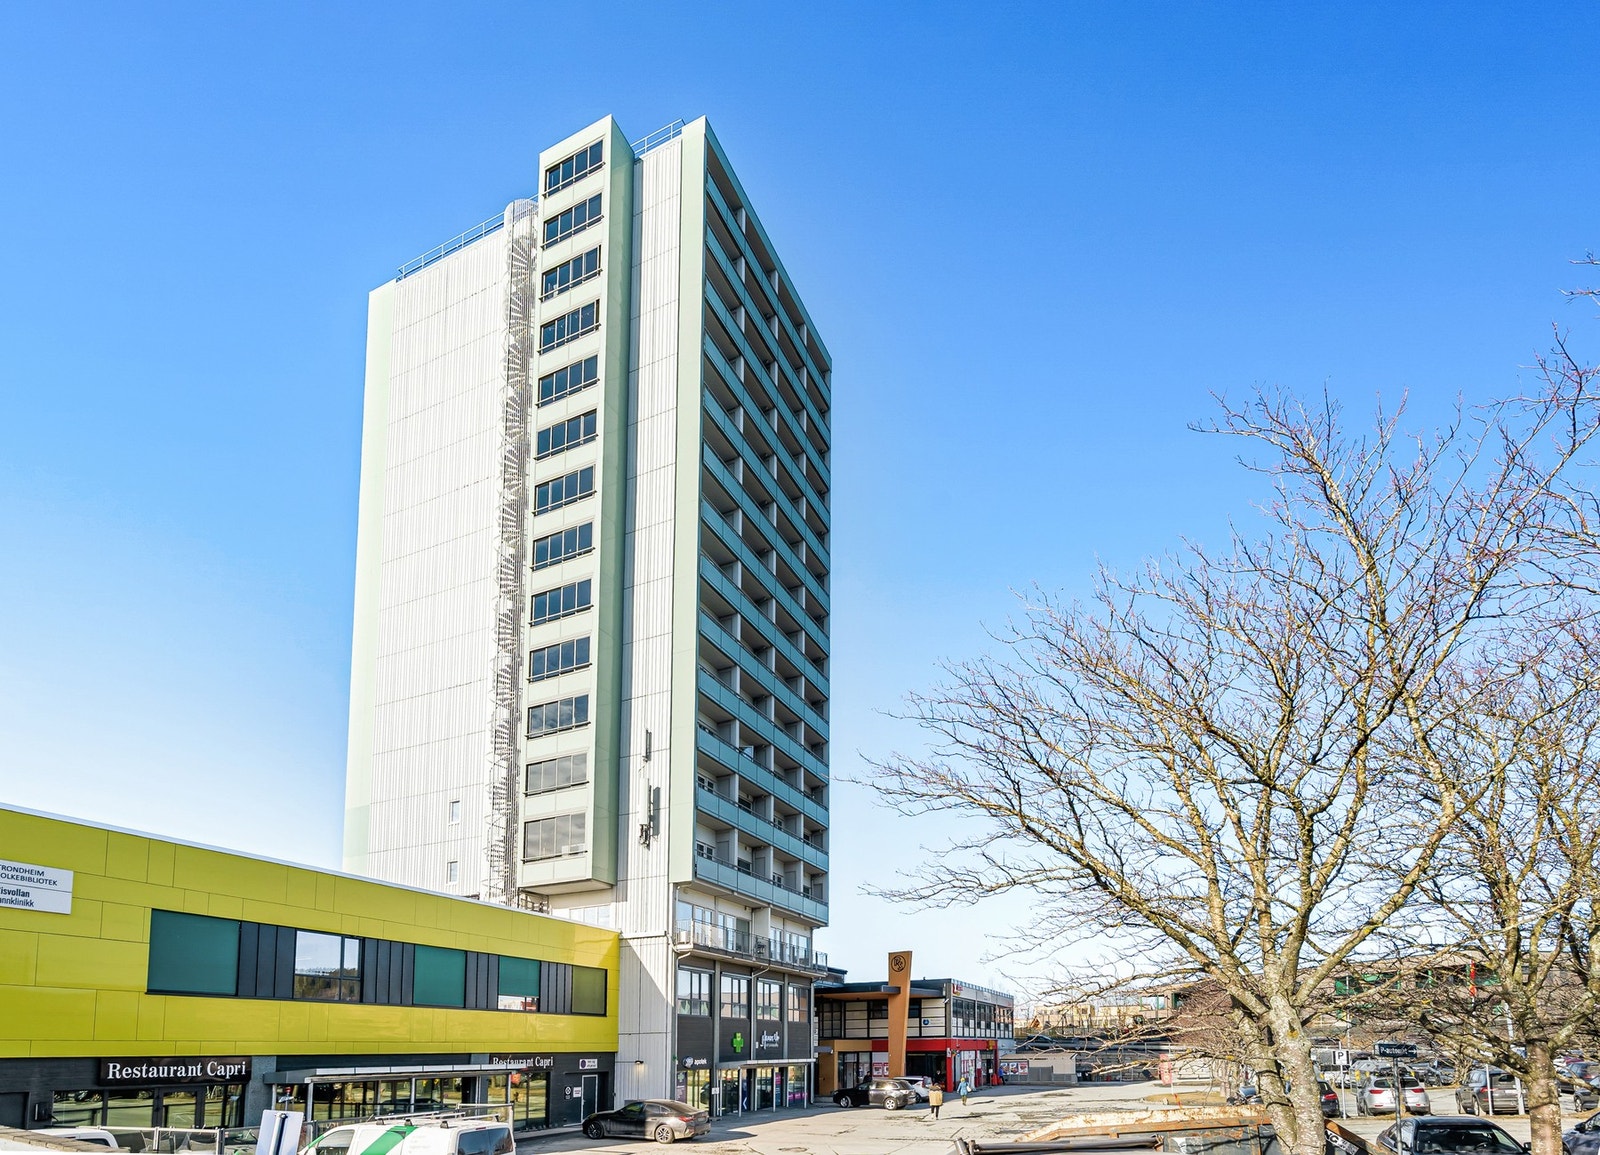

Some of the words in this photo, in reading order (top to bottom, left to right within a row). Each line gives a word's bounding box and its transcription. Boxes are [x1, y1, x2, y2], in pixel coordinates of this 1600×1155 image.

[0, 872, 58, 886] OLKEBIBLIOTEK
[0, 887, 30, 898] isvollan
[0, 897, 35, 908] nnklinikk
[535, 1056, 553, 1068] Capri
[107, 1062, 203, 1079] Restaurant
[206, 1061, 246, 1079] Capri
